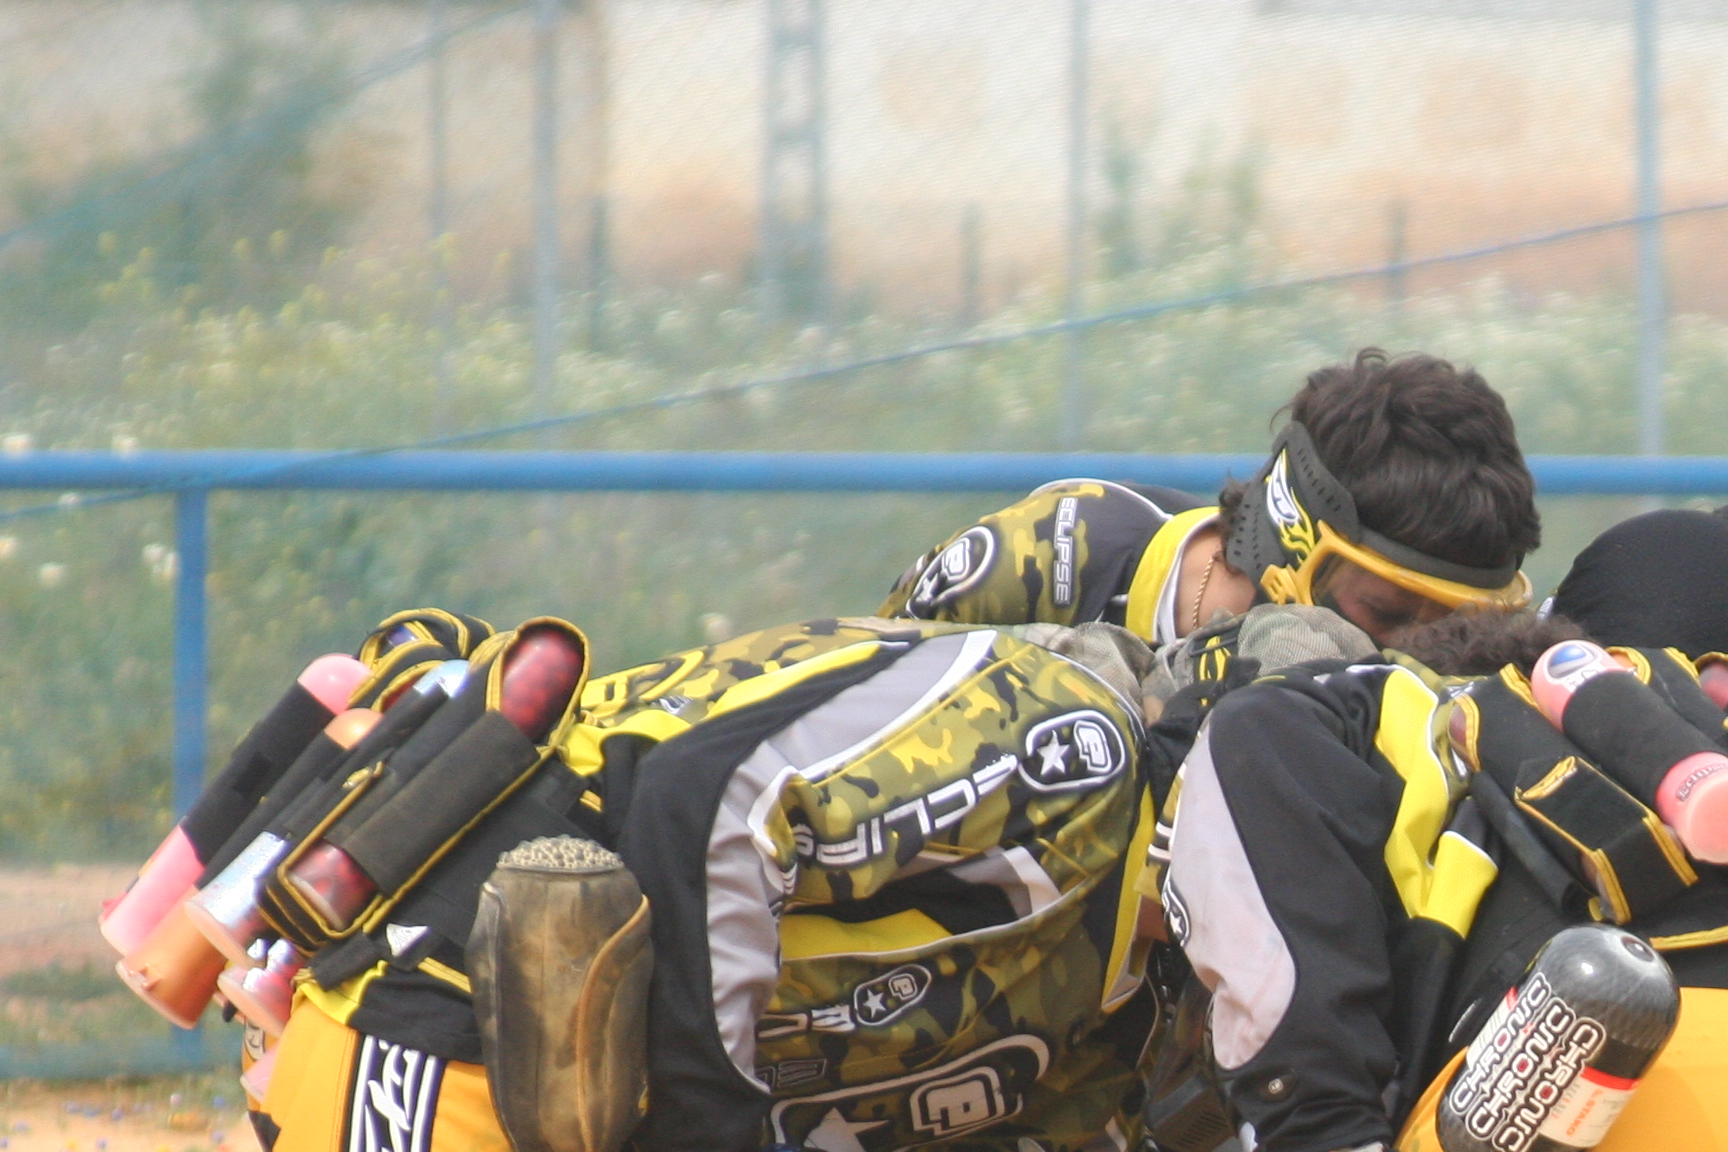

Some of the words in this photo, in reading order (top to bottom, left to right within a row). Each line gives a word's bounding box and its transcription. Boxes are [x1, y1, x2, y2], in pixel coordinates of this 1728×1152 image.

[1053, 497, 1078, 605] ECLIPSE
[1450, 972, 1552, 1114] CHRONIC
[1466, 997, 1576, 1140] CHRONIC
